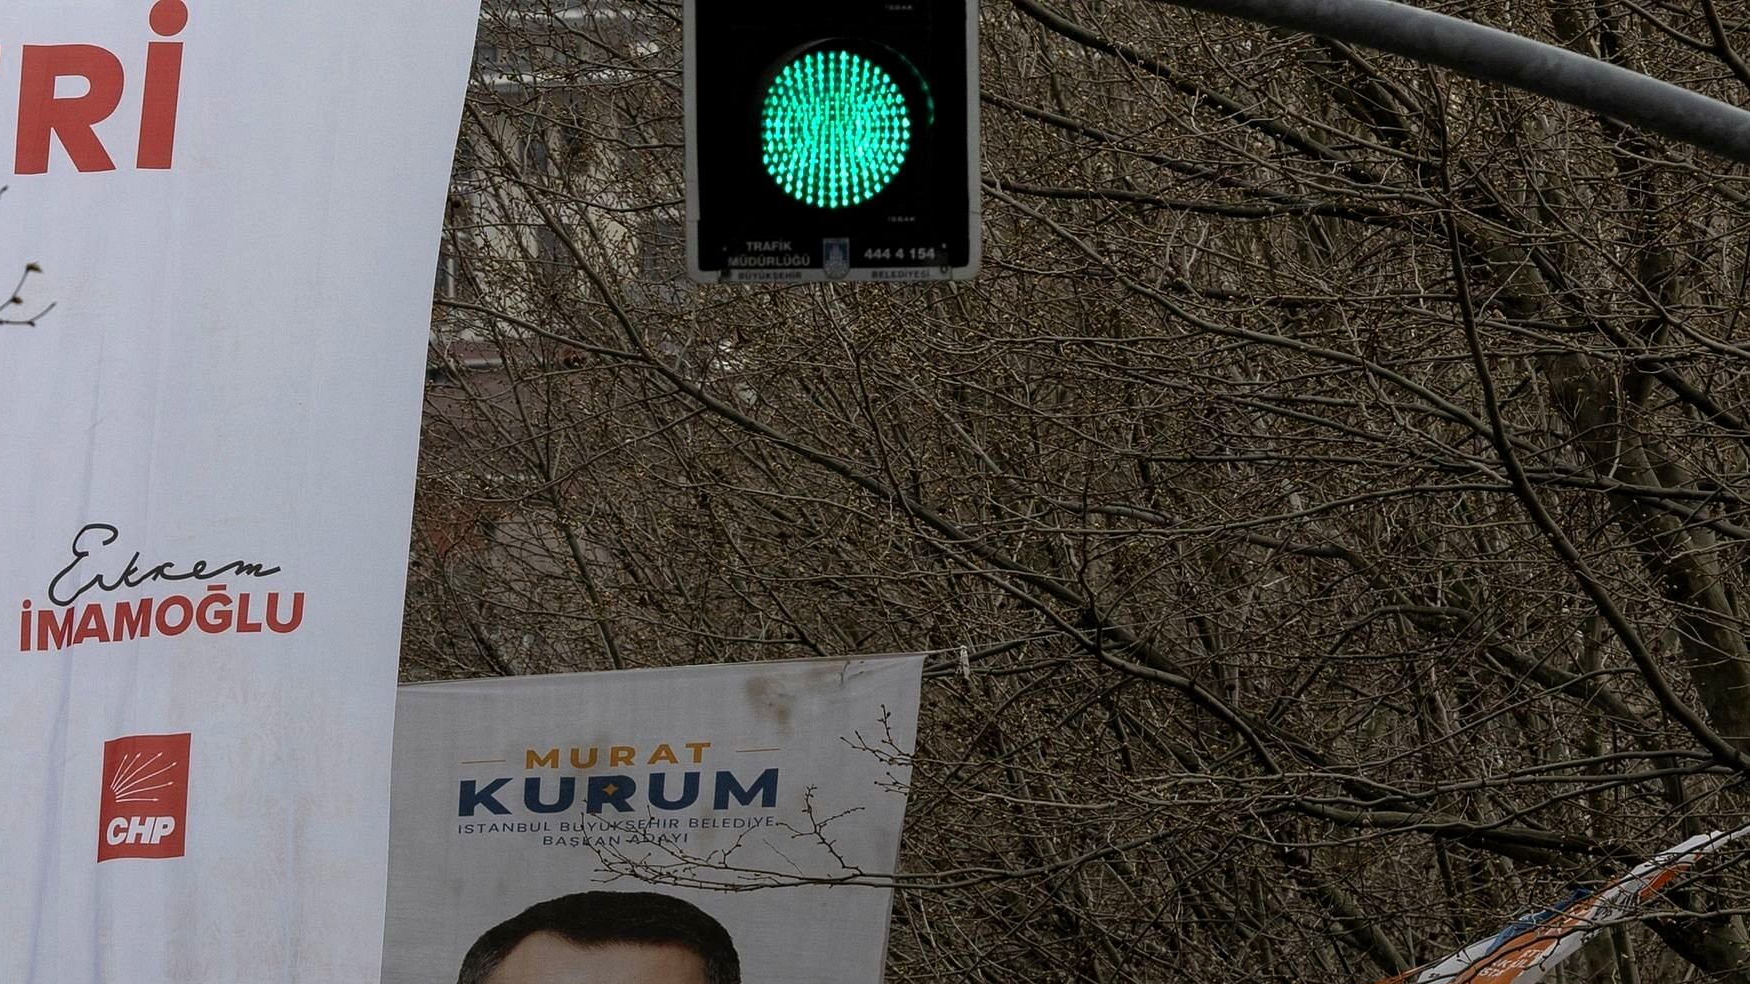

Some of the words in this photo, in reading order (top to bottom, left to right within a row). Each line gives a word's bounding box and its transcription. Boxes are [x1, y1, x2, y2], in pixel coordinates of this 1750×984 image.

[863, 247, 891, 260] 444
[895, 247, 903, 259] 4
[909, 247, 936, 259] 154
[19, 584, 306, 652] İMAMOĞLU
[525, 741, 711, 770] MURAT
[458, 768, 779, 817] KURUM
[106, 816, 176, 845] CHP
